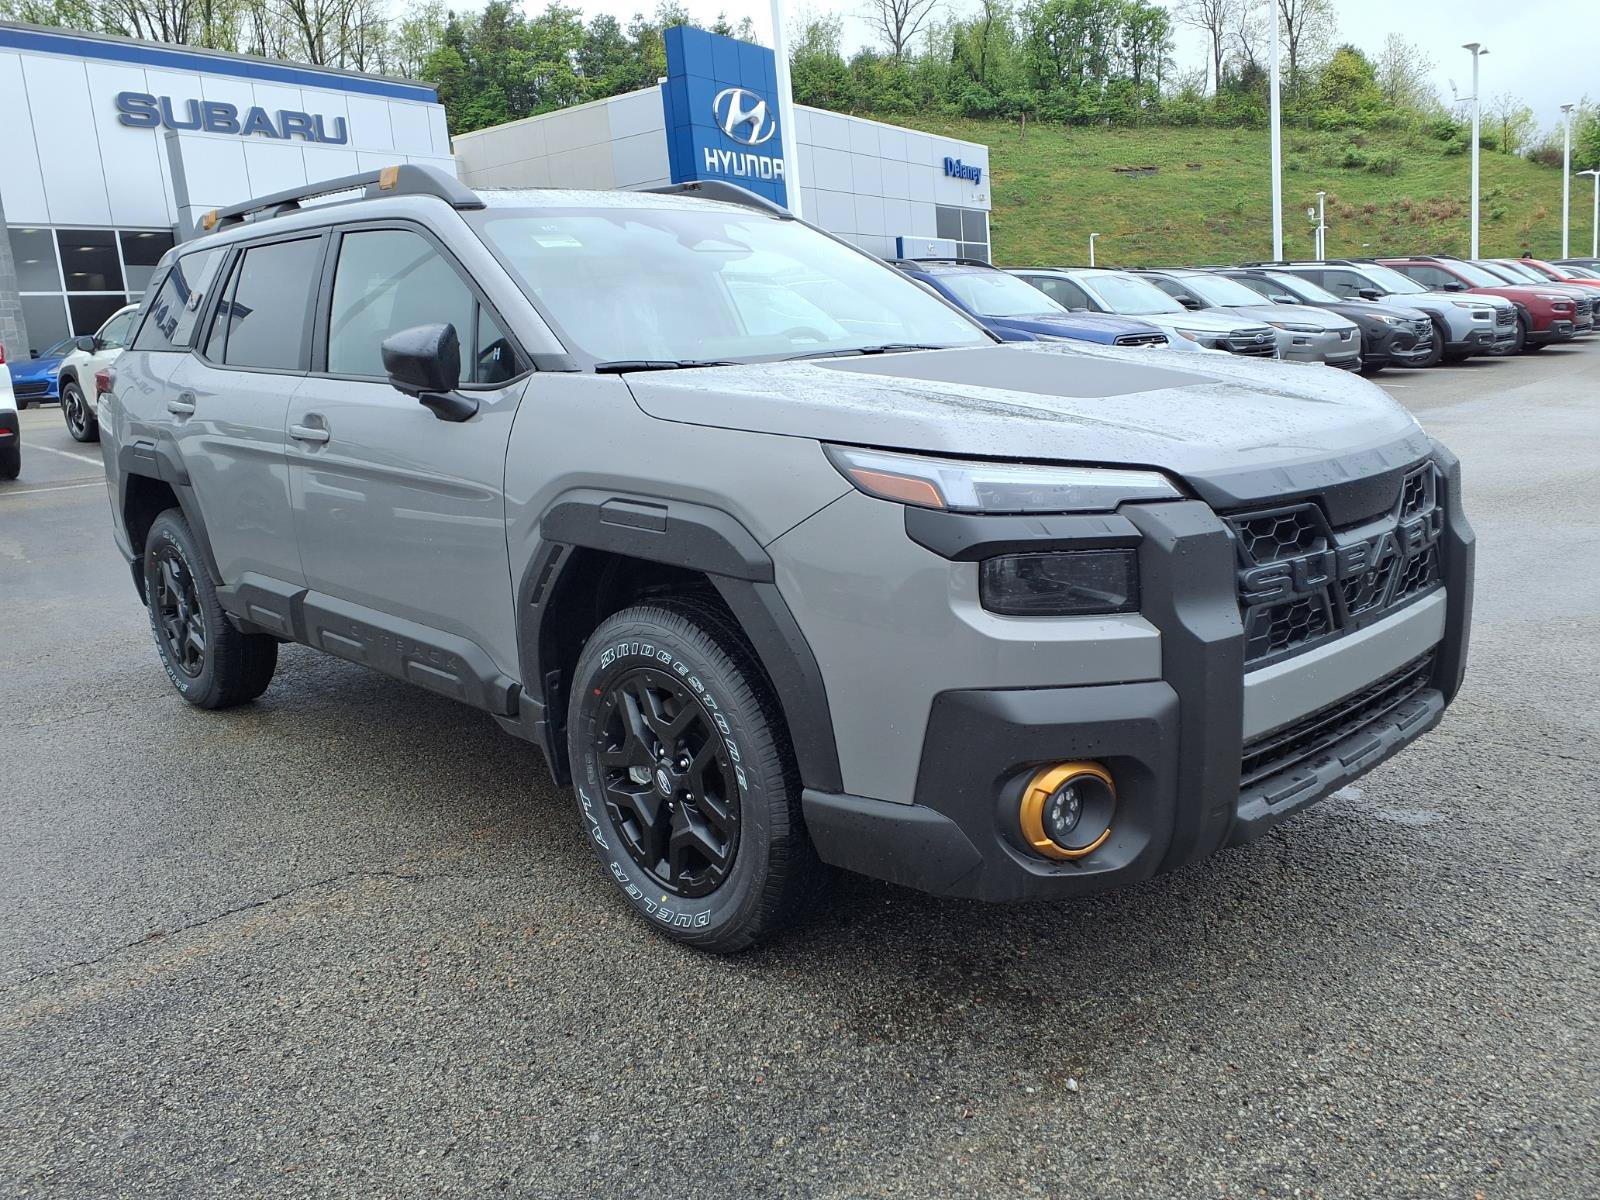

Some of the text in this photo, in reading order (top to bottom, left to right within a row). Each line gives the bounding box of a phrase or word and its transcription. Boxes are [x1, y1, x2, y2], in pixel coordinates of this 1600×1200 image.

[116, 91, 348, 146] SUBARU
[704, 147, 785, 180] HYUNDA
[944, 156, 982, 185] Delaney
[1238, 506, 1443, 607] SUBARU
[600, 642, 748, 791] BRIDGESTONE
[579, 787, 711, 928] DUELER A/T
